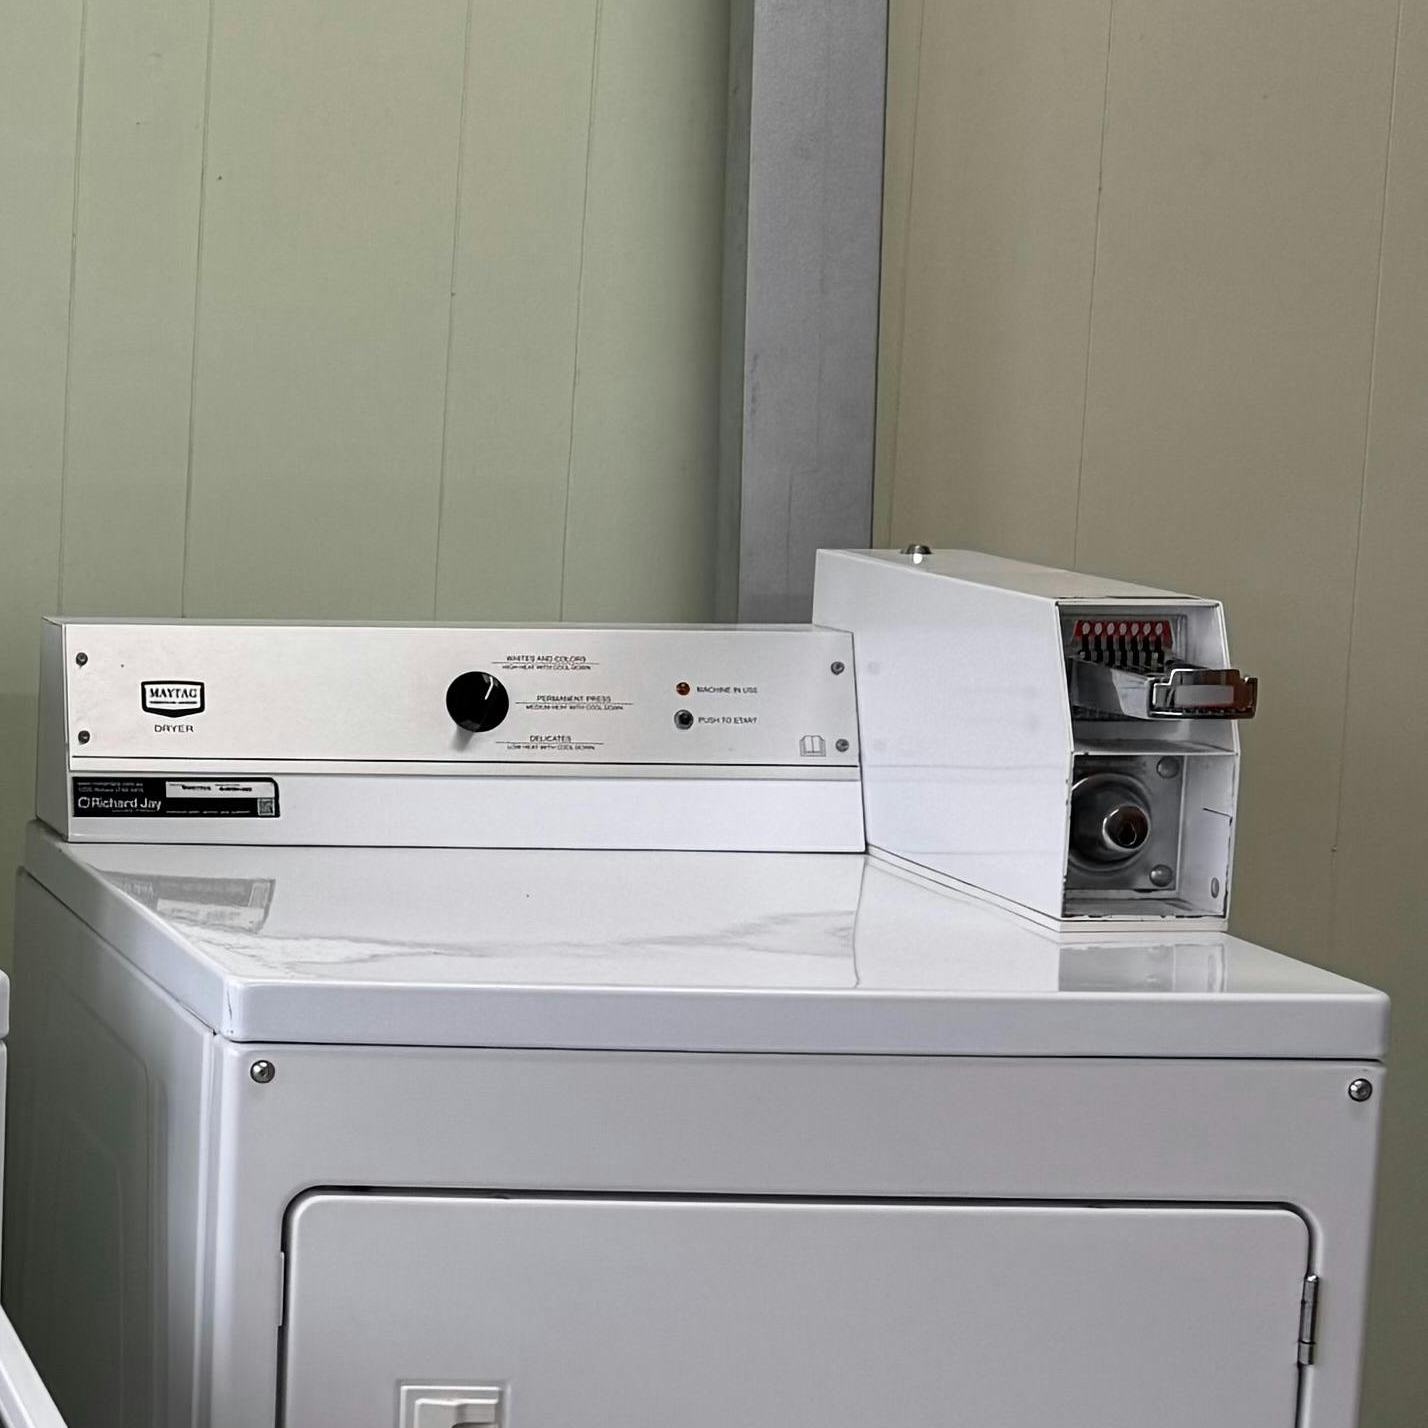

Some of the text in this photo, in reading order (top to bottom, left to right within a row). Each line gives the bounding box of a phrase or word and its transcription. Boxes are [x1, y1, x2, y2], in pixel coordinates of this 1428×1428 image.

[148, 687, 198, 699] MAYTAG
[154, 724, 194, 733] DRYER
[91, 797, 162, 810] Richard Jay
